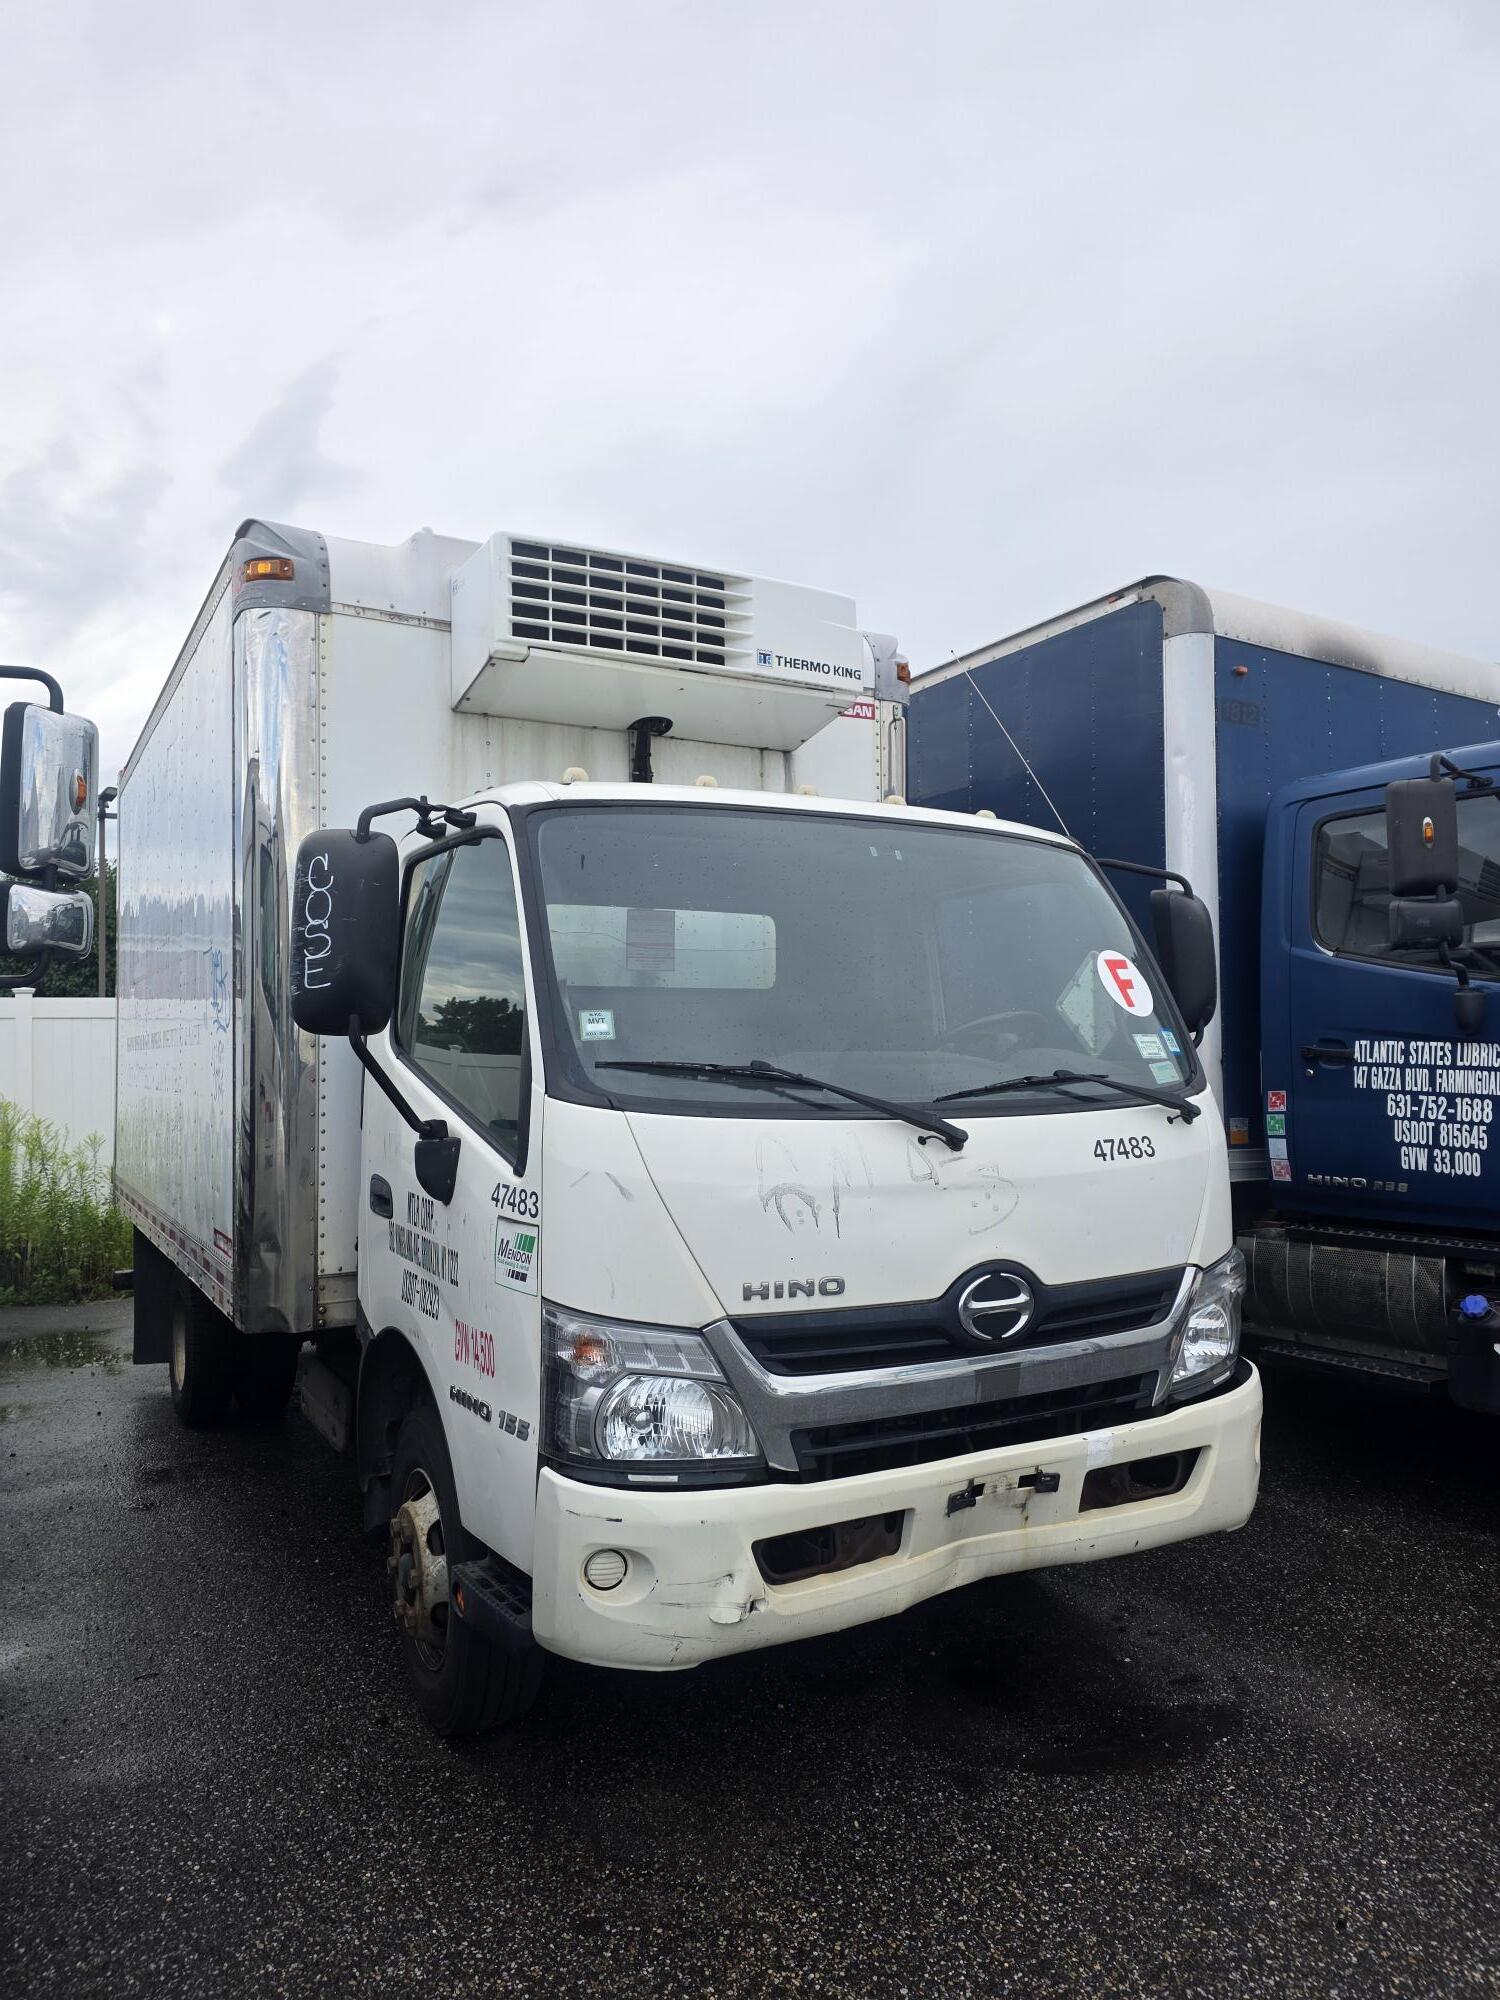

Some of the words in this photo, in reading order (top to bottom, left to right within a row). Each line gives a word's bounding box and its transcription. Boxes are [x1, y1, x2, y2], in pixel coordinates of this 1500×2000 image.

[775, 655, 831, 675] THERMO
[833, 664, 861, 680] KING
[1104, 959, 1135, 1008] F
[1353, 1040, 1404, 1065] ATLANTIC
[1409, 1041, 1452, 1066] STATES
[1353, 1066, 1368, 1089] 147
[1371, 1066, 1402, 1091] GAZZA
[1405, 1068, 1432, 1092] BLVD.
[1387, 1094, 1493, 1123] 631-752-1688
[1093, 1135, 1156, 1162] 47483
[1394, 1119, 1435, 1146] USDOT
[1439, 1122, 1488, 1151] 815645
[1400, 1146, 1428, 1171] GVW
[1433, 1148, 1481, 1178] 33,000
[1307, 1174, 1367, 1189] HINO
[491, 1182, 539, 1219] 47483
[743, 1276, 845, 1301] HINO
[454, 1318, 470, 1365] GVW
[471, 1327, 496, 1379] 14,500
[449, 1385, 493, 1423] HINO
[498, 1410, 531, 1442] 155
